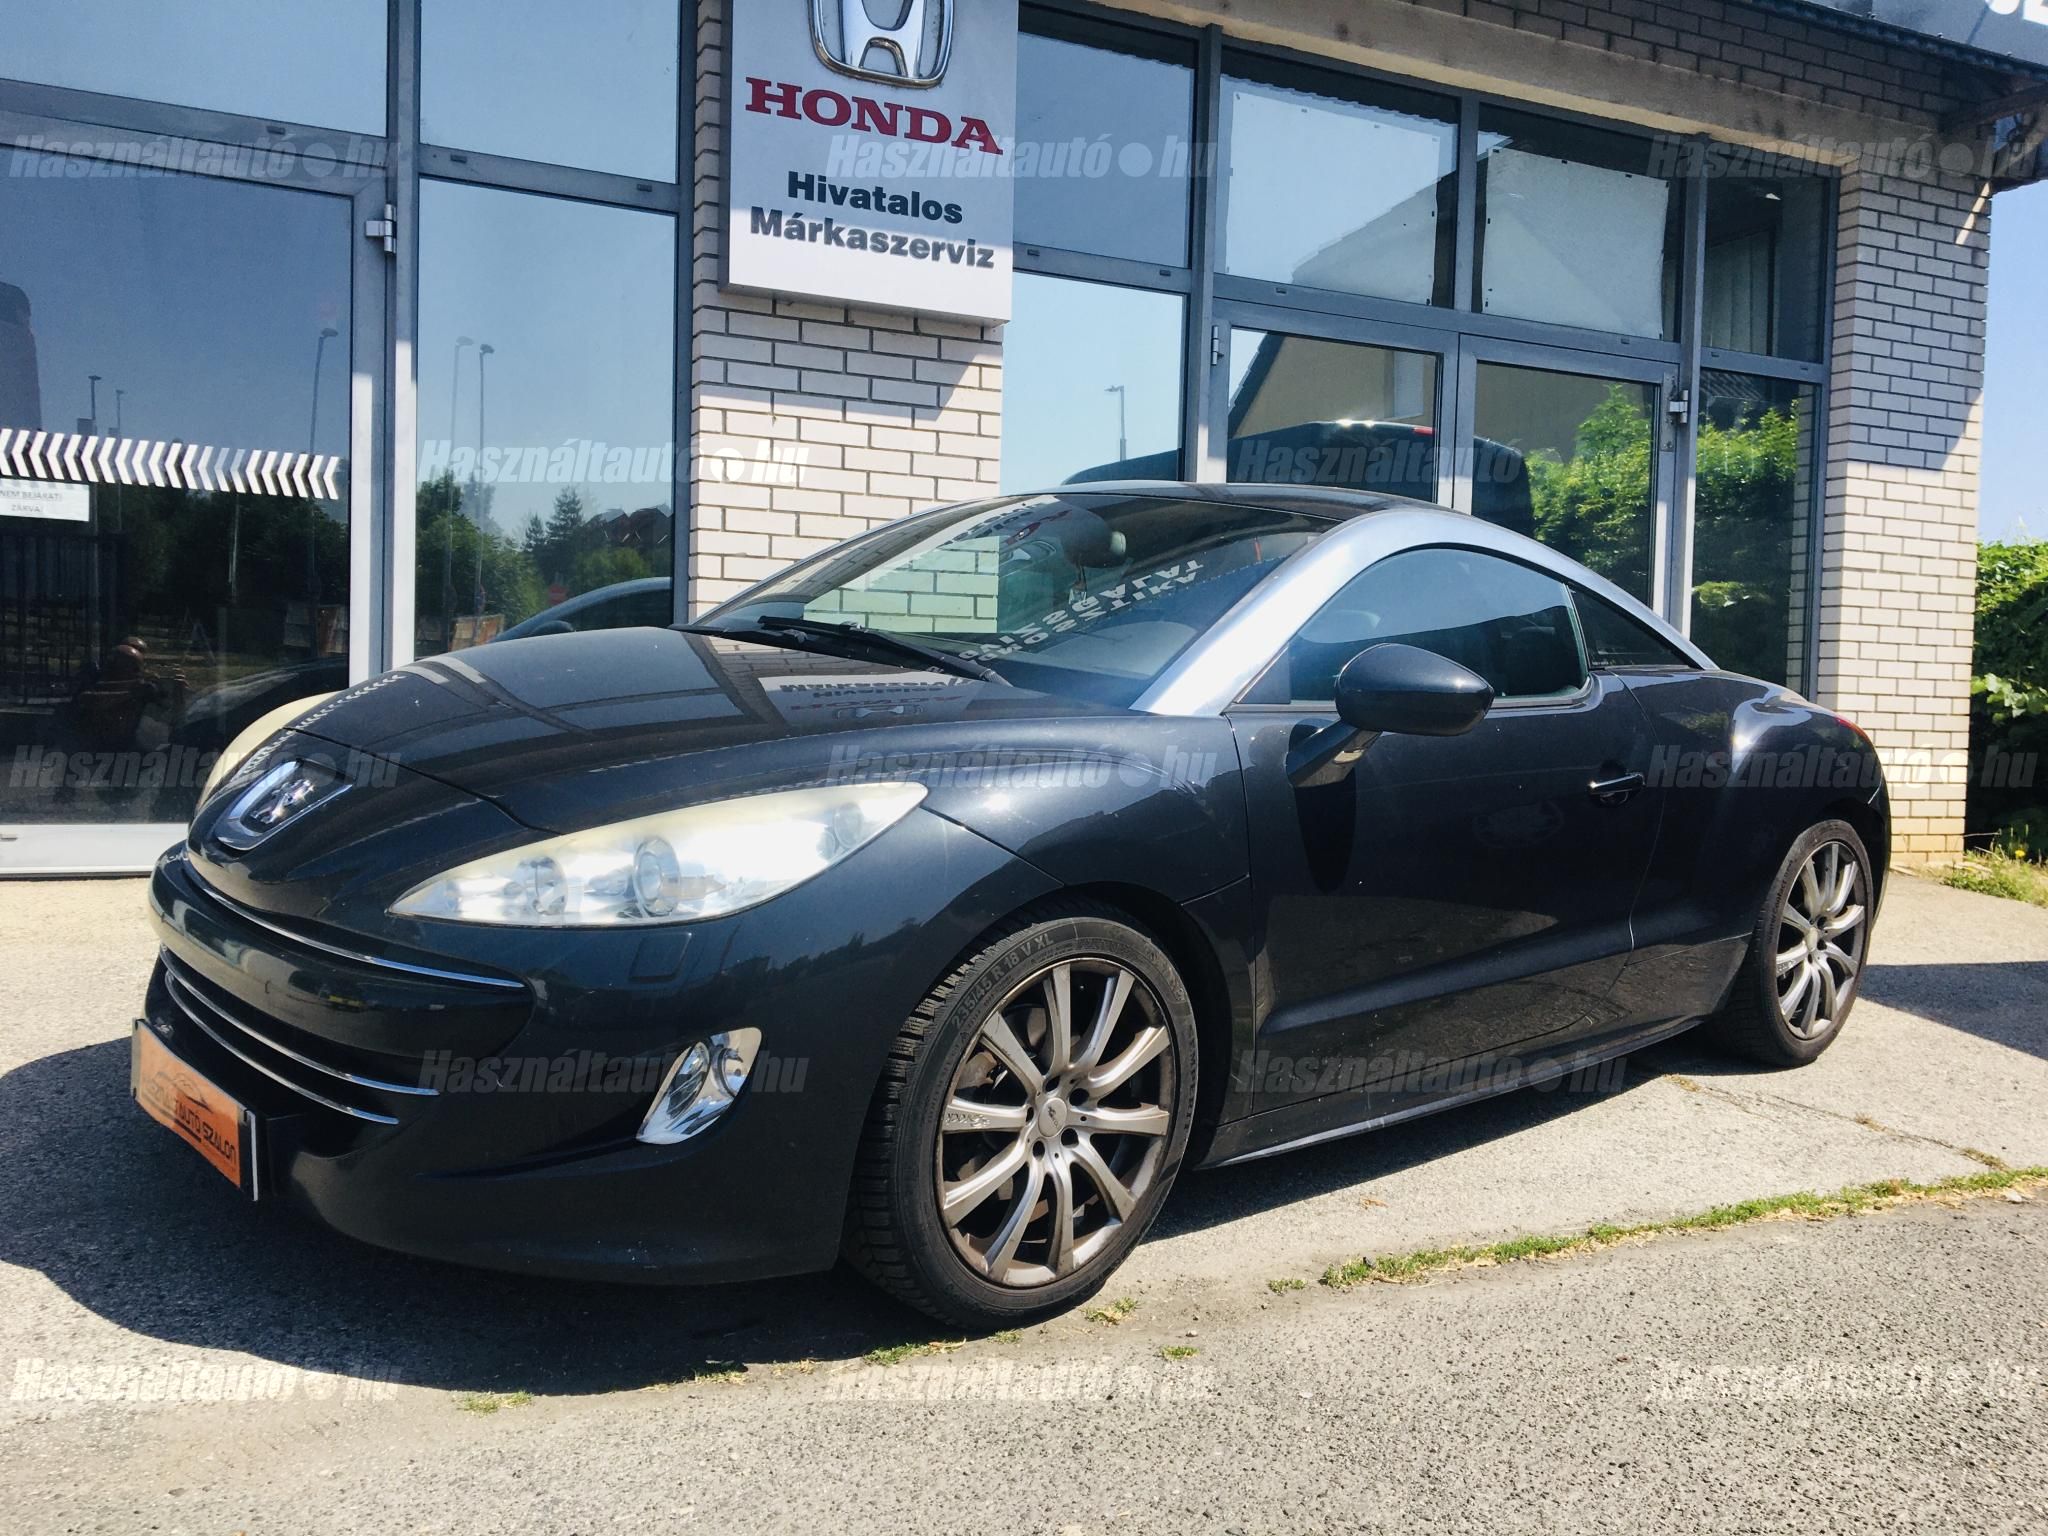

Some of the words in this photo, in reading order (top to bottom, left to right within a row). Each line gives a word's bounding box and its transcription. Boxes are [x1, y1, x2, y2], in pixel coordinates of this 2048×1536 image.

[745, 77, 1003, 155] HONDA
[787, 171, 963, 224] Hivatalos
[750, 205, 995, 269] Márkaszerviz
[951, 976, 993, 1027] 235/45
[994, 964, 1005, 981] R
[1004, 953, 1021, 970] 18
[1035, 933, 1054, 950] XL
